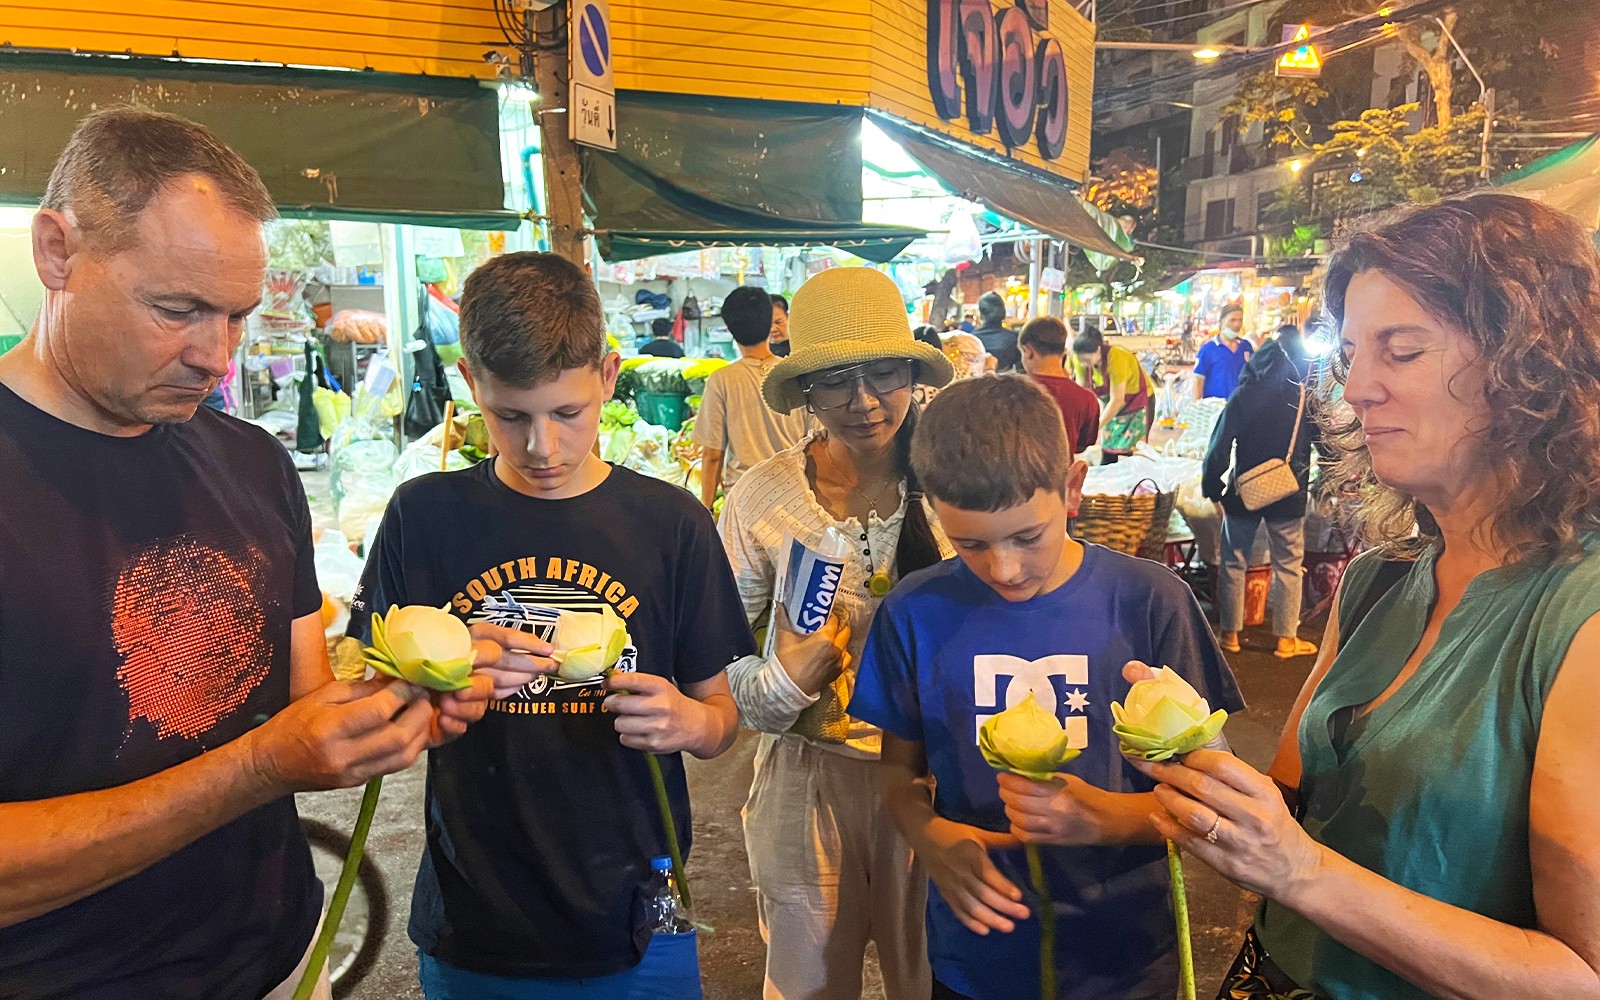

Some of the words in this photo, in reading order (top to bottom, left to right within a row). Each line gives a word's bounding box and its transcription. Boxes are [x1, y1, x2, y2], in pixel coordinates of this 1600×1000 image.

[452, 556, 537, 614] SOUTH
[546, 557, 640, 618] AFRICA
[486, 700, 556, 714] UIKSILVER
[562, 702, 595, 714] SURF
